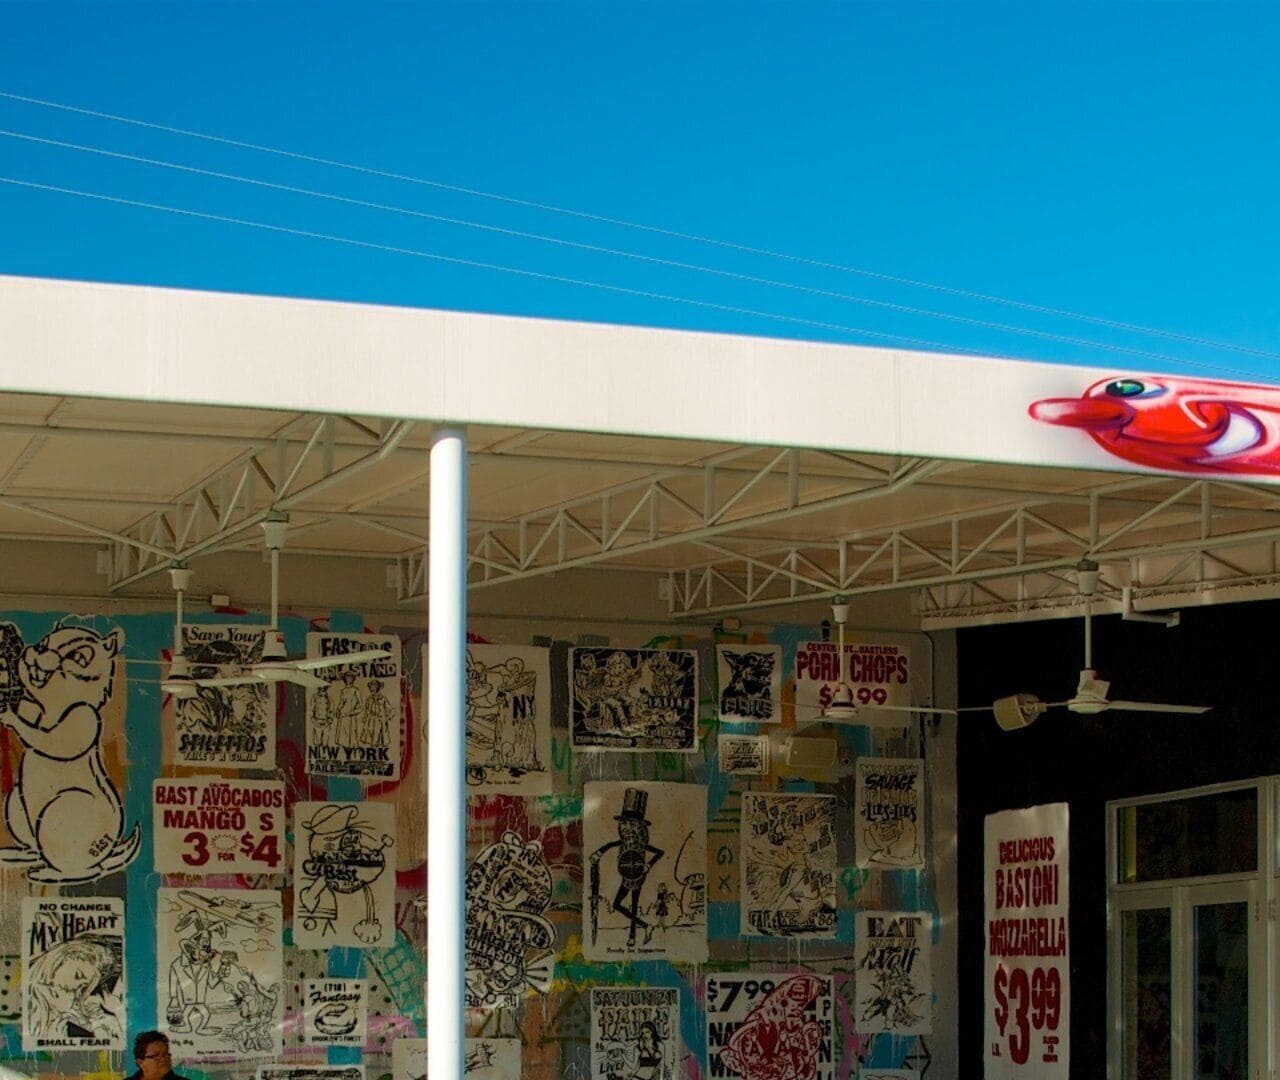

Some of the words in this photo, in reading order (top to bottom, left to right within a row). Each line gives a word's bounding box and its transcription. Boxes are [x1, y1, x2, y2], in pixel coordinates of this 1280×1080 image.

[189, 626, 224, 641] Save
[850, 654, 908, 684] CHOPS
[309, 746, 340, 760] NEW
[342, 747, 391, 761] YORK
[309, 763, 337, 772] FAILE
[156, 786, 198, 805] BAST
[201, 788, 282, 808] AVOCADOS
[182, 832, 210, 866] 3
[218, 853, 235, 861] FOR
[240, 832, 282, 867] $4
[999, 836, 1055, 865] DELICIOUS
[995, 864, 1058, 909] BASTONI
[867, 917, 922, 937] EAT
[989, 917, 1066, 957] MOZZARELLA
[599, 1007, 670, 1041] FAILE
[994, 963, 1061, 1065] $399
[36, 1039, 76, 1047] SHALL
[79, 1039, 111, 1047] FEAR
